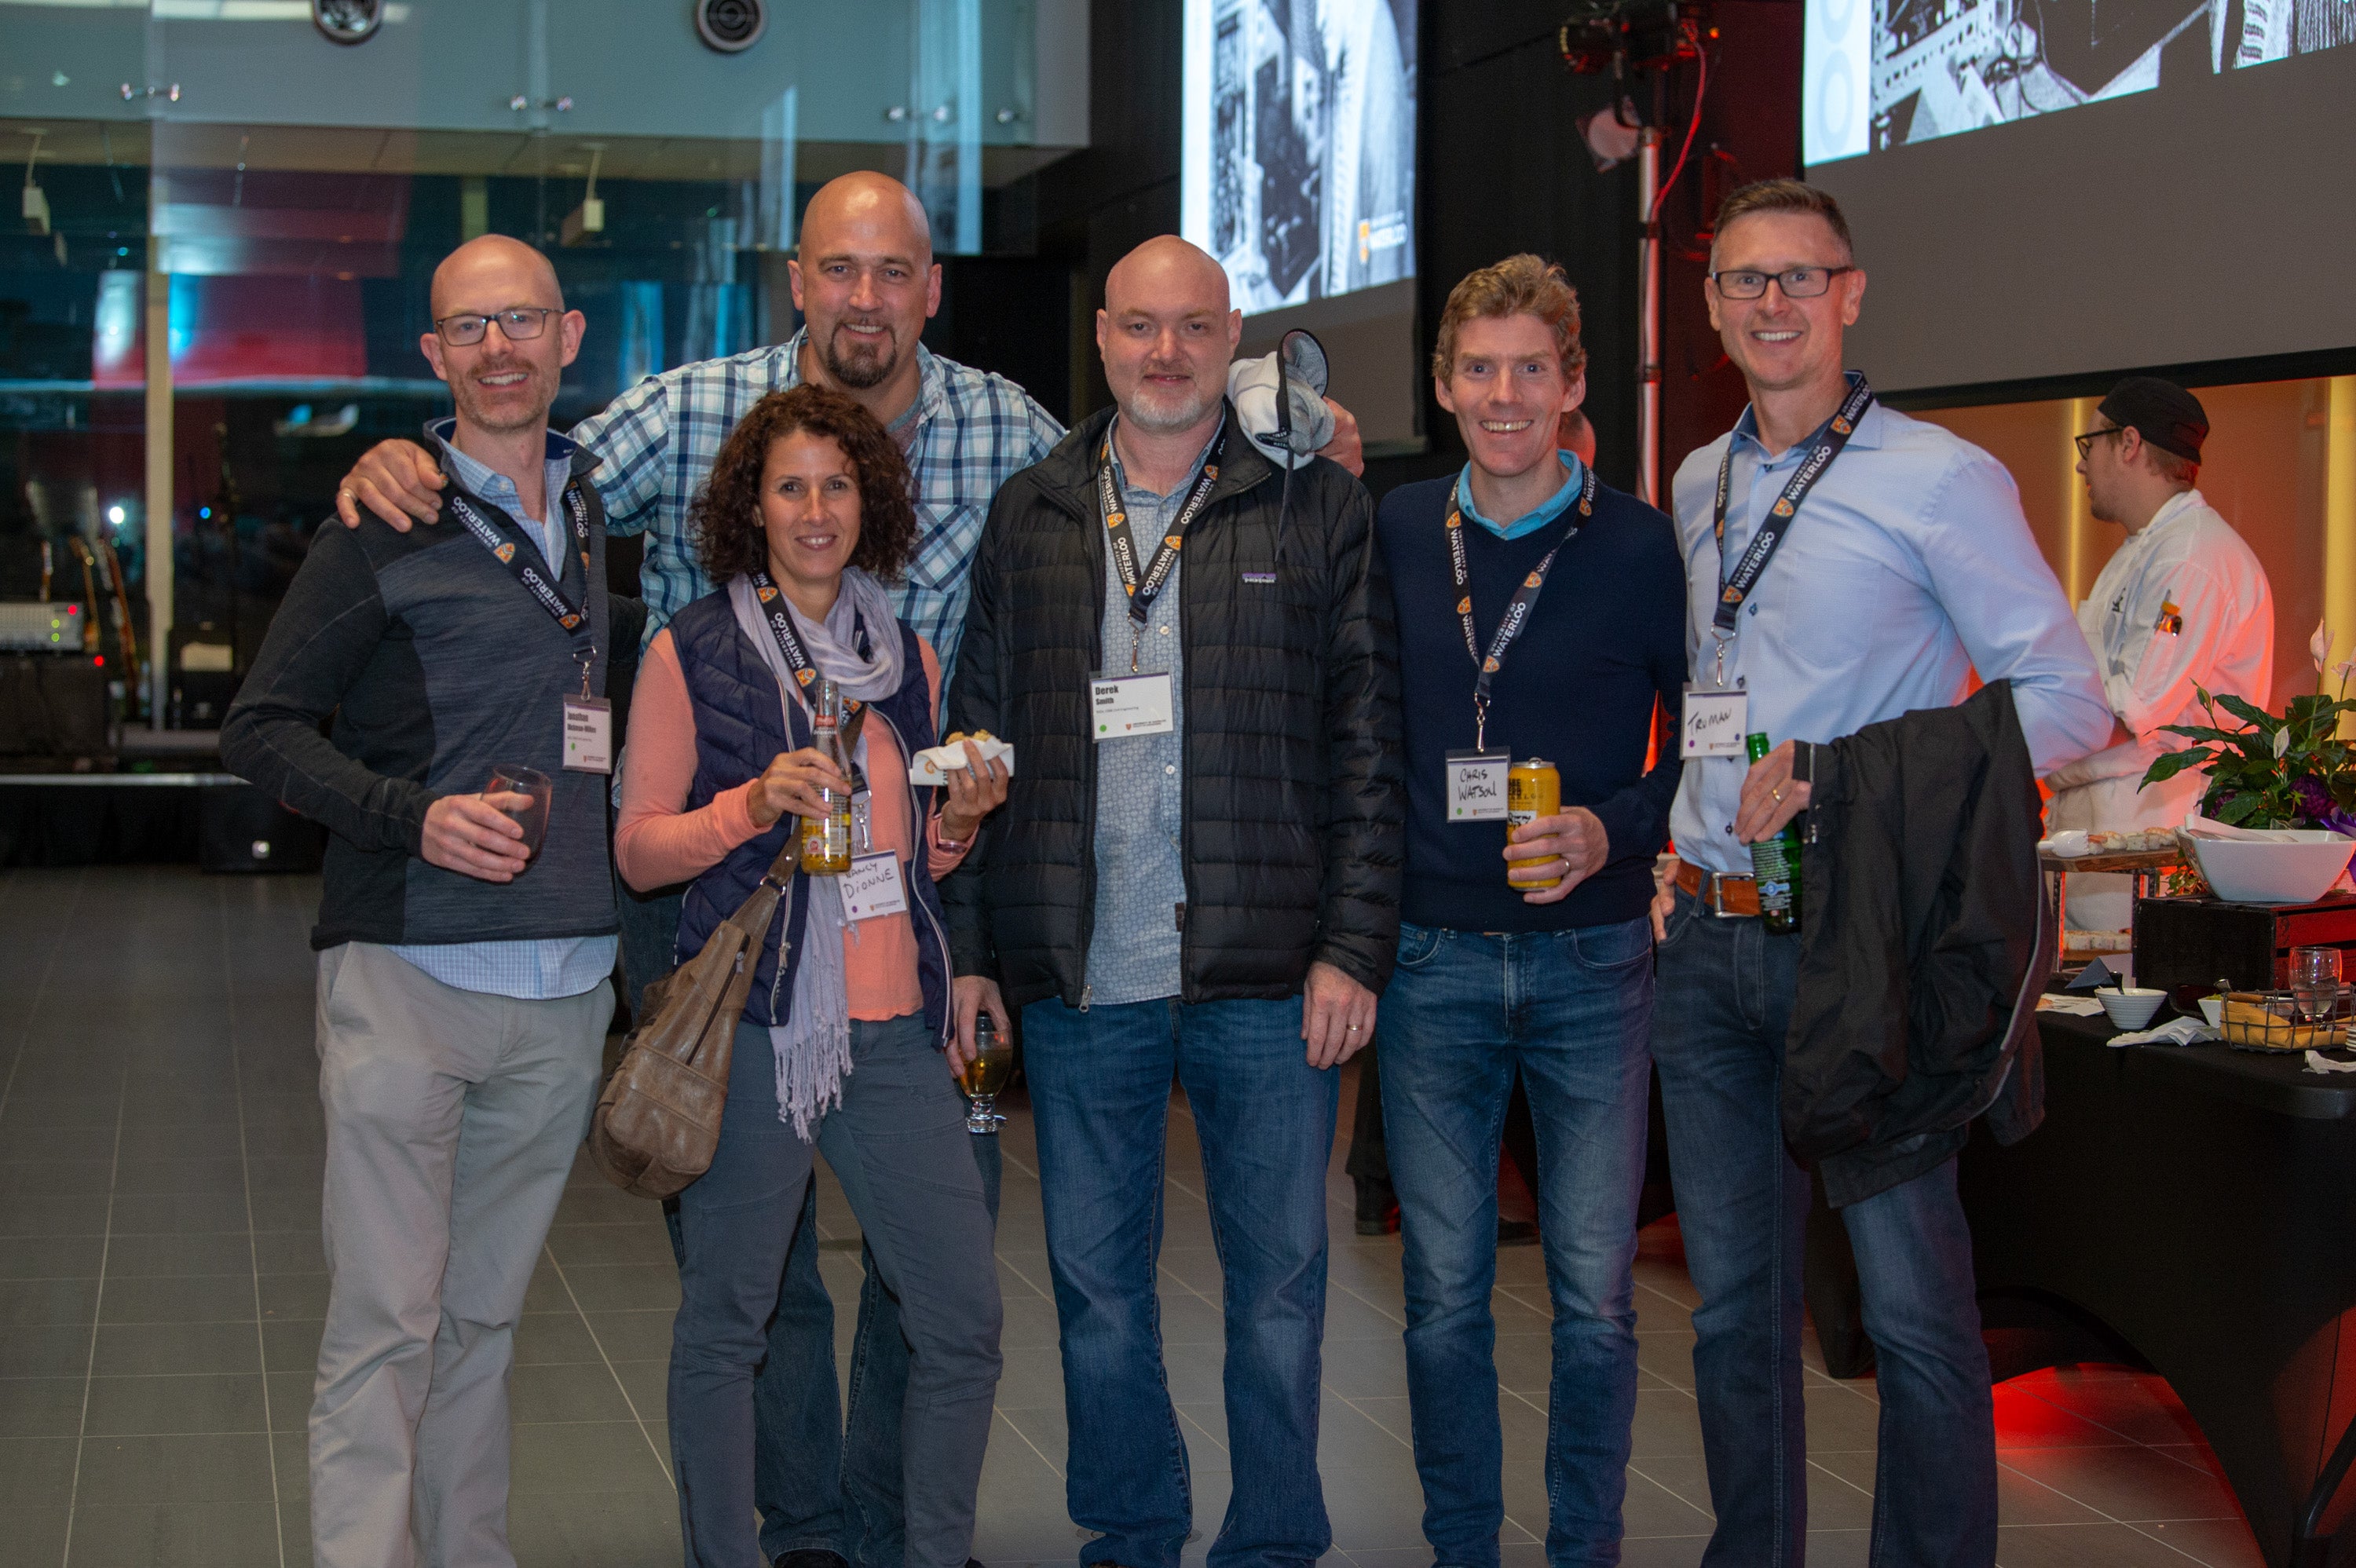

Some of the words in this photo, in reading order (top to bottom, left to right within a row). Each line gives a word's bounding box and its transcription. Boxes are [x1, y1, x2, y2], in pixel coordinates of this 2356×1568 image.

[1103, 465, 1118, 514] WATERLOO
[1787, 446, 1831, 500] WATERLOO
[453, 496, 502, 546] WATERLOO
[566, 489, 585, 538] WATERLOO
[1180, 477, 1213, 524] WATERLOO
[458, 515, 492, 548] UNIVERSITY
[1458, 529, 1466, 568] UNIVERSITY
[1118, 536, 1137, 585] WATERLOO
[1142, 548, 1173, 596] WATERLOO
[1158, 552, 1177, 586] UNIVERSITY
[1451, 528, 1464, 585] WATERLOO
[1735, 532, 1775, 589] WATERLOO
[523, 567, 568, 616] WATERLOO
[774, 612, 806, 669] WATERLOO
[775, 630, 796, 668] UNIVERSITY
[1490, 613, 1511, 652] UNIVERSITY
[1509, 602, 1516, 612] OF
[1493, 602, 1526, 656] WATERLOO
[1095, 685, 1119, 695] Derek
[1458, 780, 1497, 801] WATSON
[1460, 769, 1488, 783] CHRIS
[846, 863, 877, 879] NANCY
